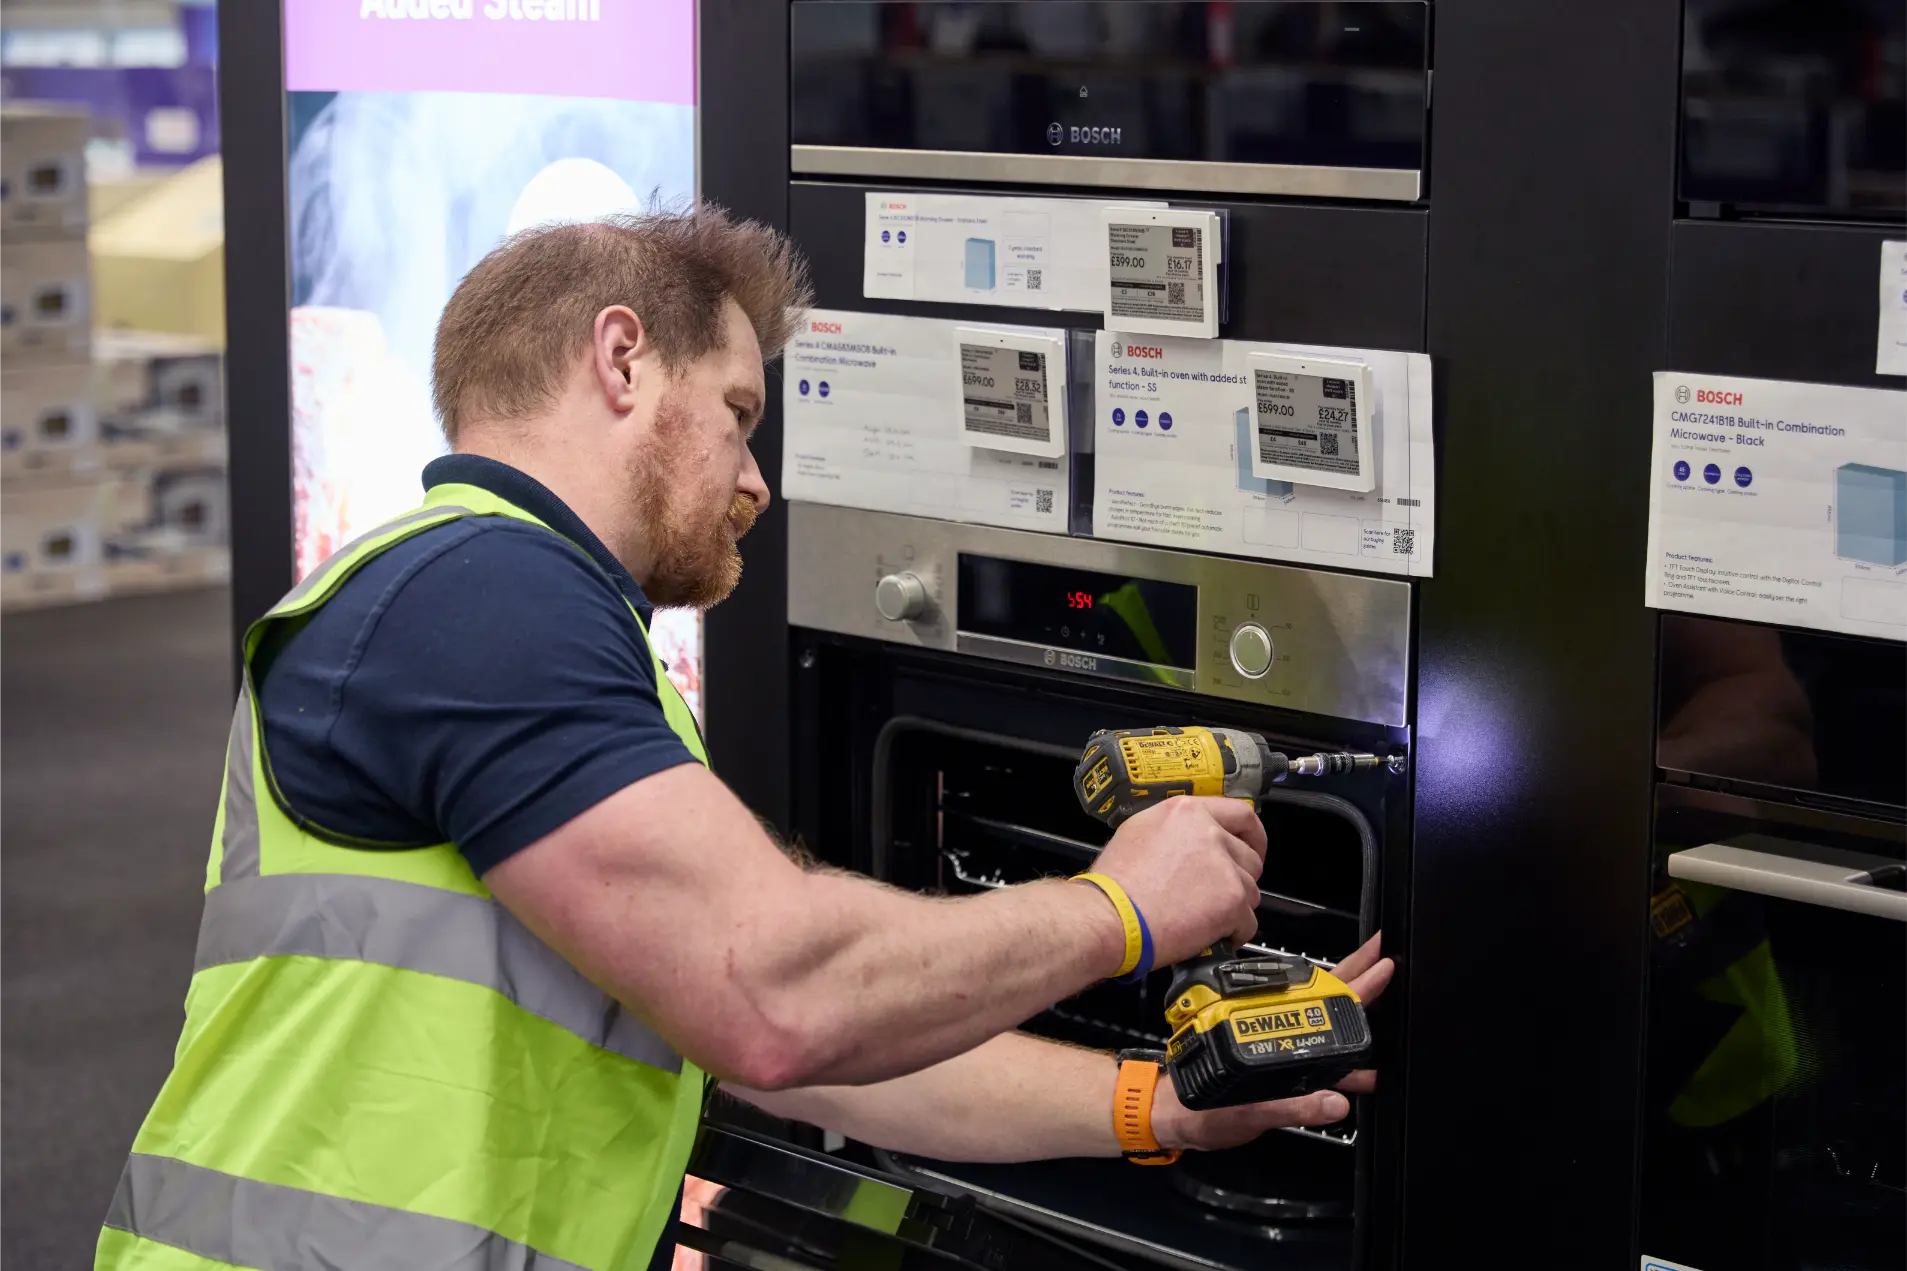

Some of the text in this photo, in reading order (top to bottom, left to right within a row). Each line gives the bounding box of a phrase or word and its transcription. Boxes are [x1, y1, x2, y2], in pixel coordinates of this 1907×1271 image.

[360, 0, 600, 21] Added Steam
[1070, 126, 1121, 144] BOSCH
[1111, 256, 1145, 268] £399.00
[1168, 259, 1192, 270] £16.17
[811, 322, 842, 334] BOSCH
[872, 346, 897, 356] Built-in
[1127, 346, 1163, 359] BOSCH
[795, 353, 877, 368] Combination Microwave
[964, 375, 995, 388] £699.00
[1108, 365, 1131, 376] Series
[1141, 367, 1169, 379] Built-in
[1170, 372, 1190, 380] oven
[1191, 371, 1208, 382] with
[1209, 373, 1238, 384] added
[1016, 380, 1042, 393] £28.32
[1108, 380, 1140, 391] function
[1147, 382, 1157, 392] SS
[1697, 390, 1743, 405] BOSCH
[1258, 402, 1295, 417] £599.00
[1318, 408, 1349, 422] £24.27
[1671, 411, 1845, 436] CMG7241B1B Built-in Combination
[1670, 428, 1726, 443] Microwave
[1736, 434, 1765, 447] Black
[1108, 488, 1125, 496] Product
[1665, 551, 1714, 564] Product features:
[1664, 571, 1675, 580] Ring
[1679, 564, 1695, 572] Touch
[1717, 569, 1739, 577] intuitive
[1739, 572, 1759, 580] control
[1782, 576, 1800, 586] Digital
[1800, 578, 1823, 588] Control
[1667, 581, 1682, 589] Oven
[1682, 583, 1707, 592] Assistant
[1719, 587, 1735, 595] Voice
[1758, 593, 1775, 602] easily
[1060, 653, 1097, 670] BOSCH
[1306, 1008, 1322, 1018] 4.0
[1248, 1041, 1273, 1055] 18V
[1278, 1039, 1296, 1051] XR
